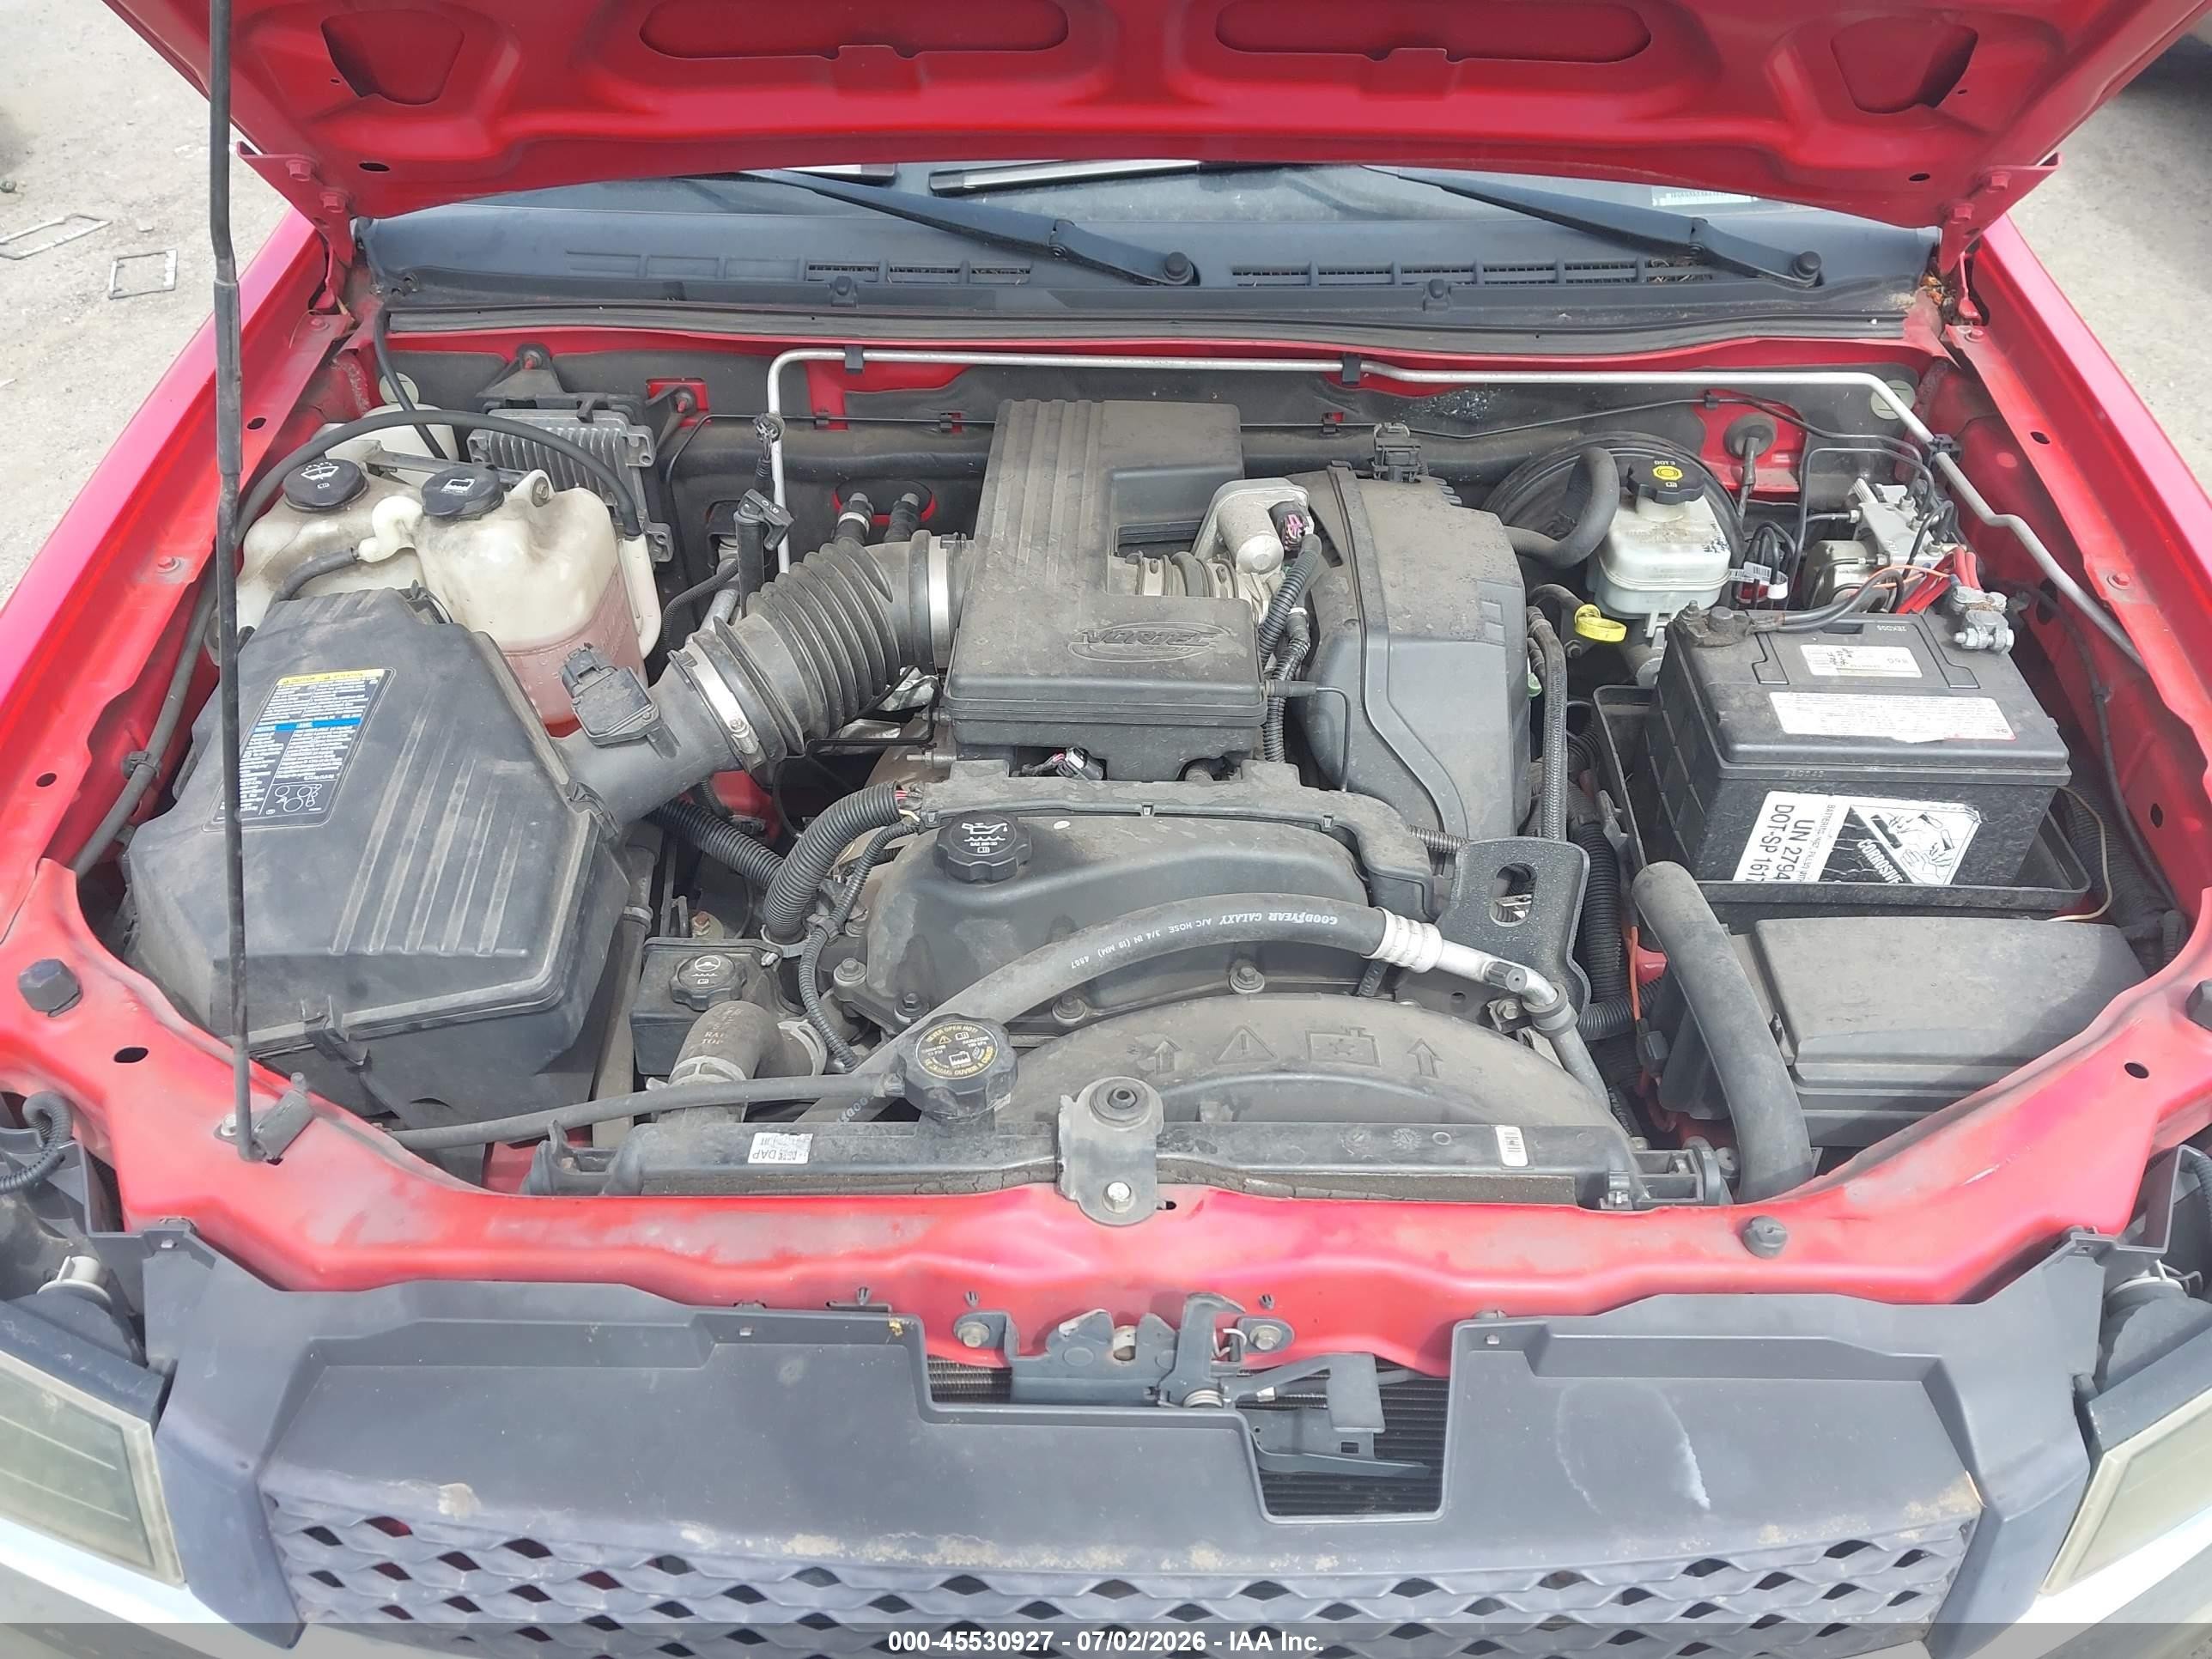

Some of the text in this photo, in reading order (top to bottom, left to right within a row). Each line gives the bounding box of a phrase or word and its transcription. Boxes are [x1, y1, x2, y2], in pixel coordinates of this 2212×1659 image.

[1759, 804, 1795, 853] DOT-SP
[1788, 819, 1816, 842] UN
[1194, 918, 1212, 927] A/C
[1219, 911, 1262, 926] GALAXY
[1268, 911, 1338, 926] GOODYEAR
[1146, 928, 1162, 940] 3/4
[1168, 921, 1193, 933] HOSE
[1133, 934, 1144, 944] IN
[1097, 944, 1115, 957] MM)
[926, 1028, 944, 1043] NEVER
